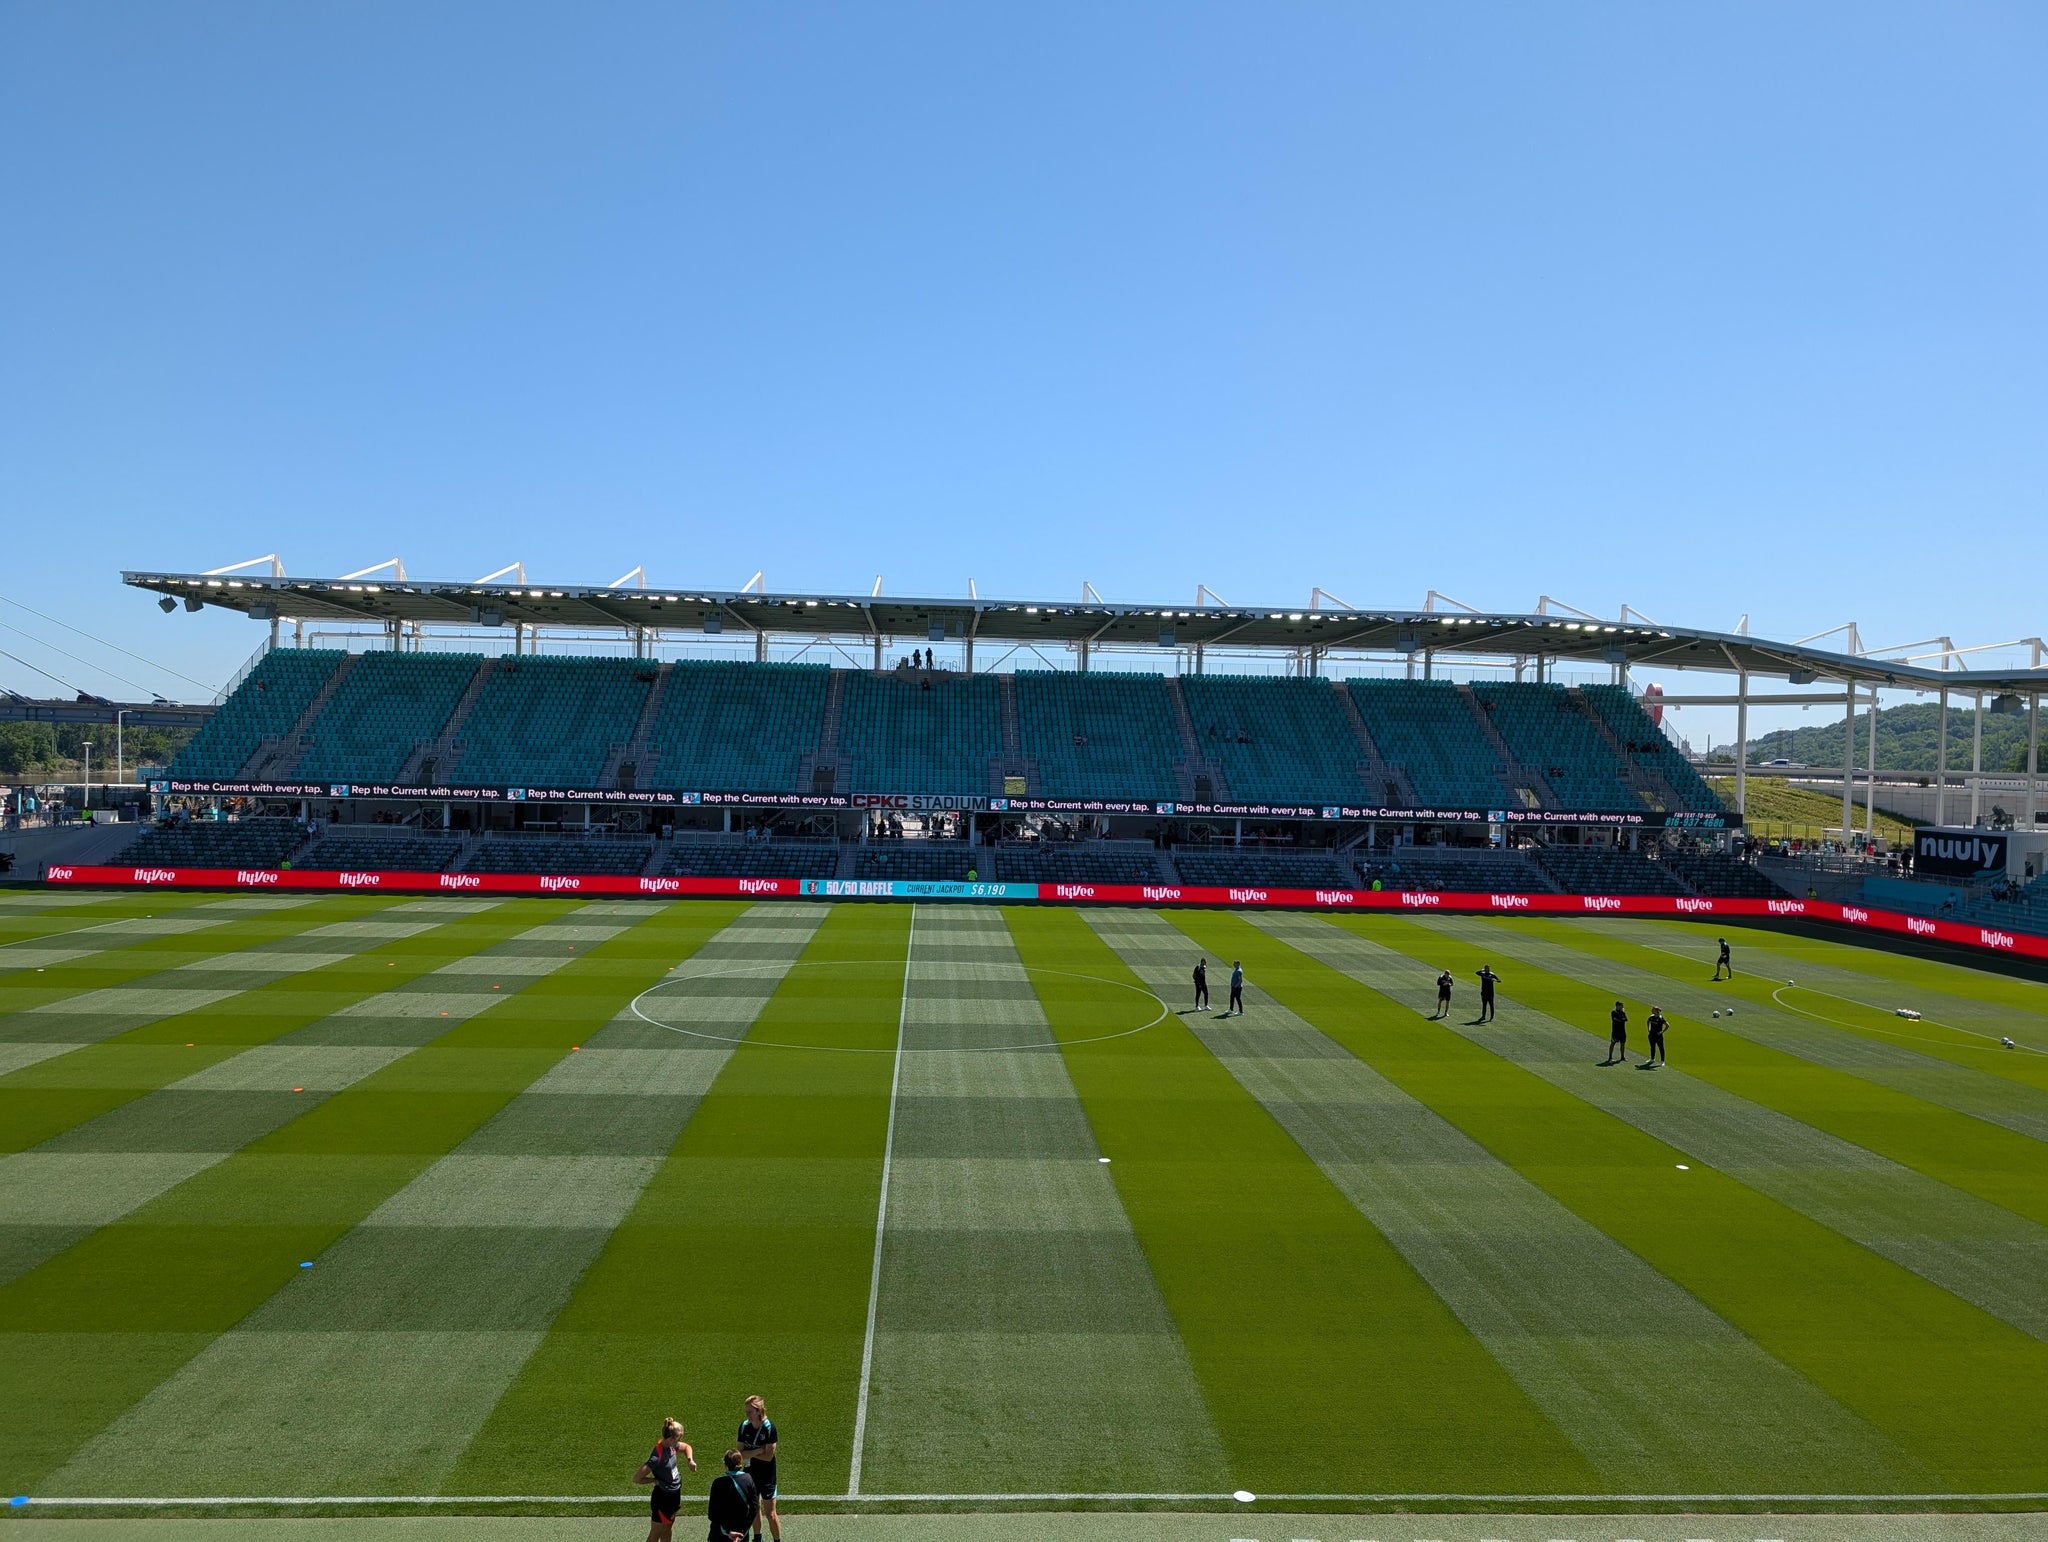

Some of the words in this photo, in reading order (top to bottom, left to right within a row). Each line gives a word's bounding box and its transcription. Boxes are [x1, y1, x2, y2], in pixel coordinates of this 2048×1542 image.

[172, 782, 191, 792] Rep
[193, 782, 210, 791] the
[212, 783, 250, 792] Current
[251, 783, 273, 792] with
[275, 786, 302, 795] every
[304, 785, 323, 795] tap.
[352, 785, 371, 796] Rep
[373, 786, 389, 795] the
[391, 786, 428, 796] Current
[430, 787, 451, 796] with
[453, 789, 480, 798] every
[482, 789, 500, 799] tap.
[528, 789, 547, 800] Rep
[549, 790, 565, 798] the
[567, 790, 603, 799] Current
[605, 791, 626, 800] with
[628, 793, 655, 802] every
[657, 793, 675, 803] tap.
[703, 793, 722, 804] Rep
[724, 794, 740, 802] the
[742, 794, 778, 803] Current
[779, 795, 800, 803] with
[802, 797, 828, 806] every
[830, 797, 848, 806] tap.
[853, 795, 908, 808] CPKC
[912, 796, 985, 810] STADIUM
[1010, 799, 1028, 810] Rep
[1030, 800, 1045, 809] the
[1047, 800, 1082, 809] Current
[1083, 801, 1103, 810] with
[1105, 804, 1131, 812] every
[1132, 803, 1150, 813] tap.
[1176, 803, 1194, 814] Rep
[1196, 804, 1211, 812] the
[1213, 804, 1248, 814] Current
[1249, 805, 1269, 814] with
[1271, 808, 1297, 817] every
[1298, 807, 1316, 817] tap.
[1342, 808, 1360, 818] Rep
[1362, 808, 1378, 817] the
[1379, 808, 1414, 818] Current
[1415, 809, 1435, 818] with
[1437, 812, 1462, 821] every
[1464, 811, 1481, 821] tap.
[1507, 811, 1525, 822] Rep
[1527, 812, 1542, 820] the
[1544, 812, 1577, 821] Current
[1579, 813, 1598, 821] with
[1600, 815, 1625, 824] every
[1627, 815, 1644, 824] tap.
[1665, 817, 1725, 827] 816-937-4680
[1921, 837, 1999, 868] nuuly
[135, 869, 176, 884] HyVee
[238, 871, 278, 886] HyVee
[340, 873, 380, 888] HyVee
[441, 875, 480, 889] HyVee
[541, 877, 580, 891] HyVee
[640, 878, 680, 893] HyVee
[739, 880, 778, 894] HyVee
[827, 881, 858, 895] 50/50
[860, 883, 893, 895] RAFFLE
[907, 885, 936, 894] CURRENT
[937, 885, 965, 894] JACKPOT
[1057, 885, 1095, 900] HyVee
[1144, 887, 1181, 901] HyVee
[1230, 889, 1268, 904] HyVee
[1316, 891, 1354, 905] HyVee
[1402, 893, 1440, 907] HyVee
[1492, 895, 1529, 909] HyVee
[1585, 897, 1621, 911] HyVee
[1676, 899, 1713, 913] HyVee
[1768, 901, 1805, 915] HyVee
[1843, 907, 1868, 922] HyVee
[1908, 918, 1936, 934] HyVee
[1982, 931, 2014, 948] HyVee
